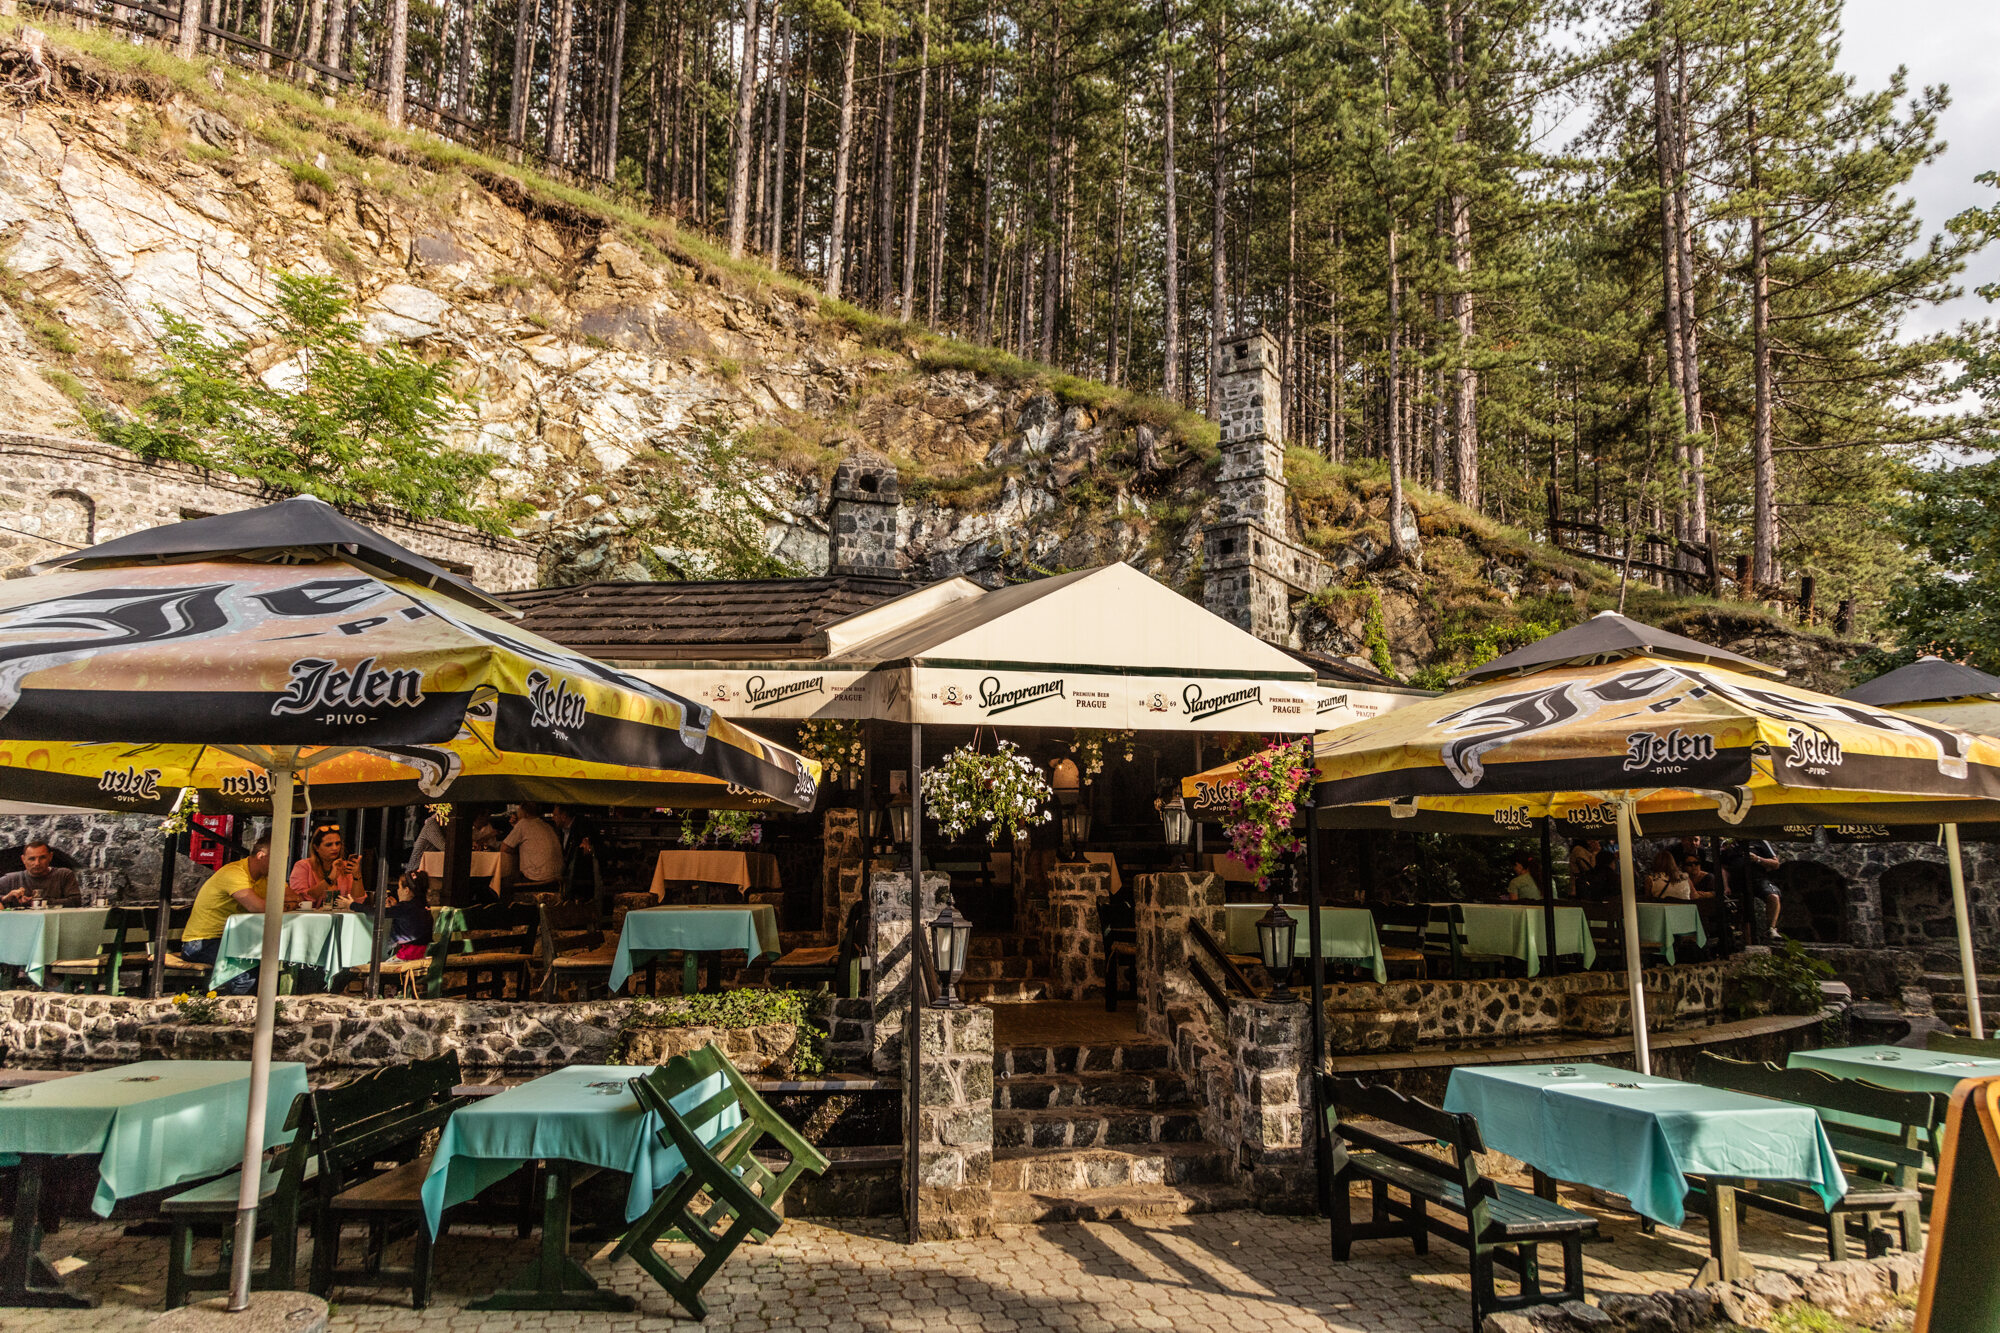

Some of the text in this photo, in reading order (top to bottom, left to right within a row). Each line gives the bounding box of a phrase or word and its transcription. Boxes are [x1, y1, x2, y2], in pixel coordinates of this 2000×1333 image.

[271, 657, 426, 716] Jelen
[526, 669, 587, 729] Jelen
[745, 675, 825, 711] Staropramen
[834, 693, 863, 702] PRAGUE
[964, 693, 973, 701] 69
[979, 676, 1066, 717] Staropramen
[1076, 699, 1107, 709] PRAGUE
[1182, 683, 1263, 723] Staropramen
[1272, 705, 1301, 714] PRAGUE
[1623, 728, 1717, 771] Jelen
[1786, 727, 1843, 768] Jelen
